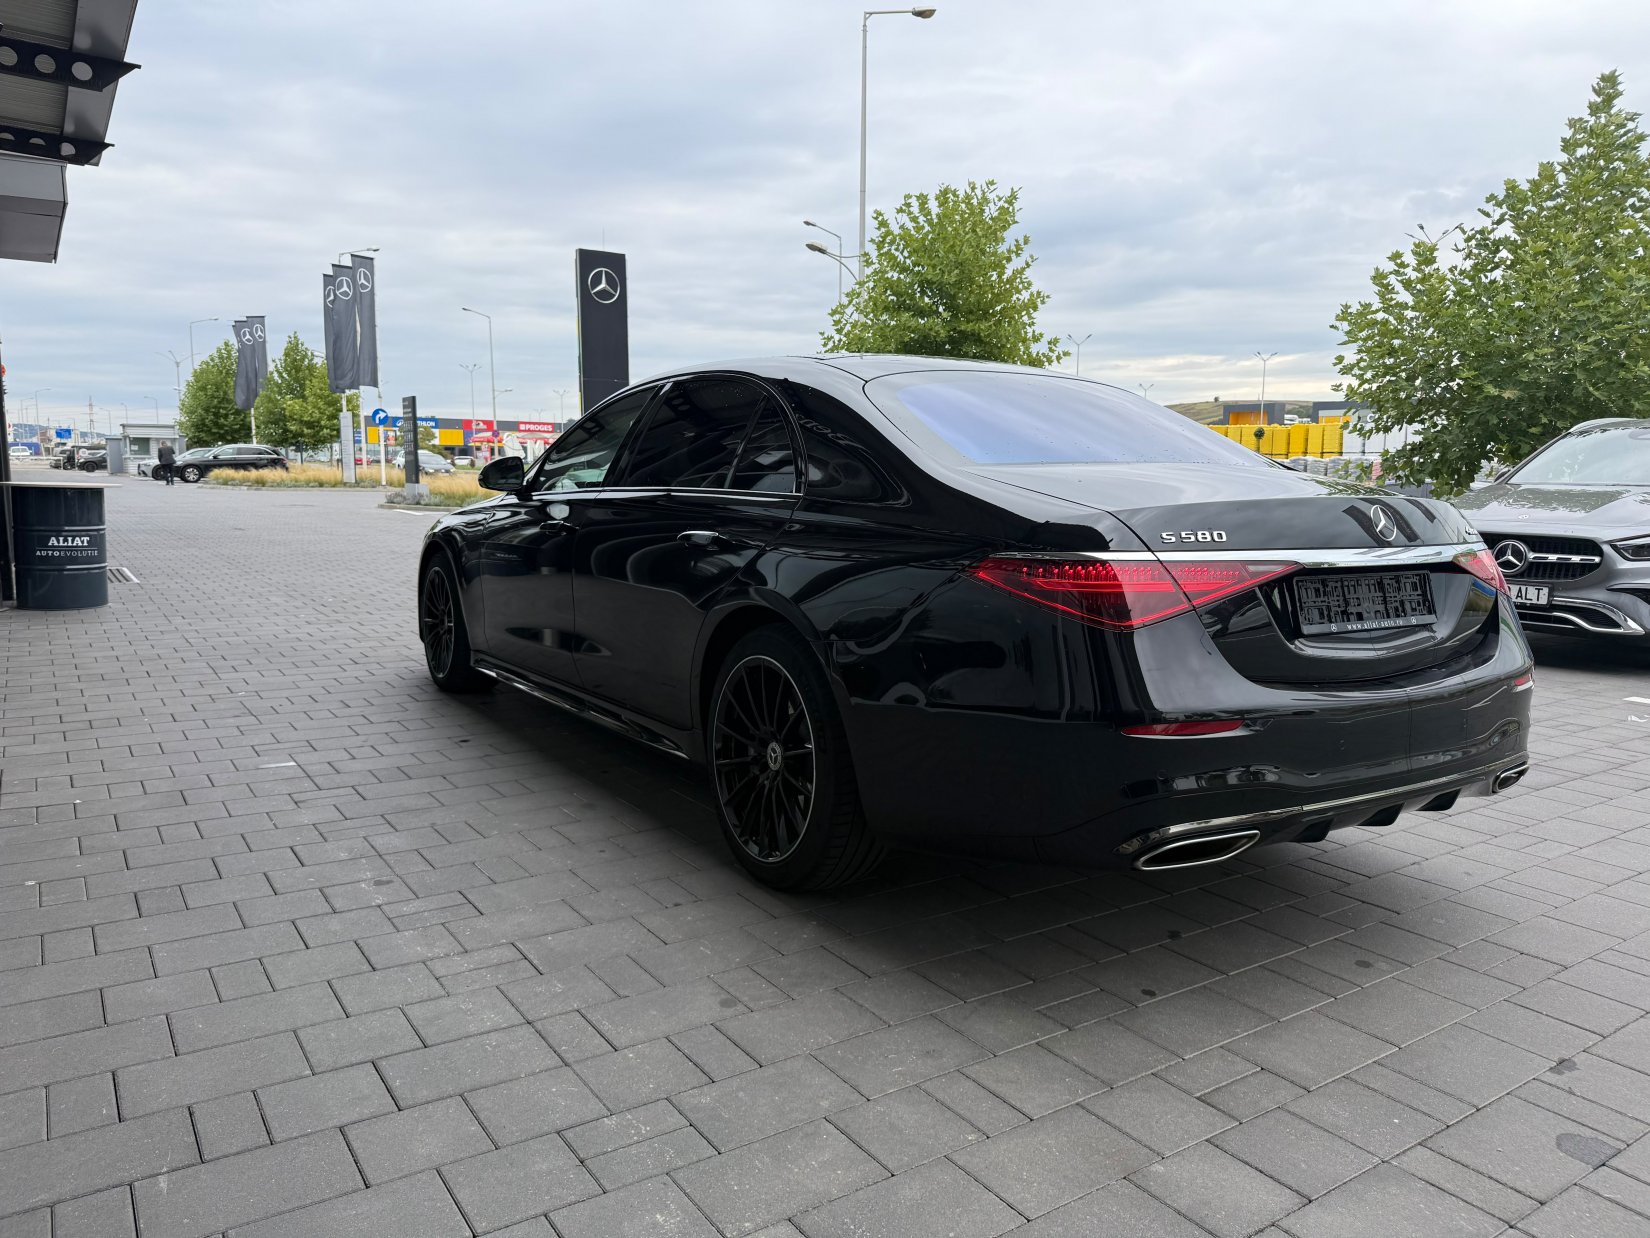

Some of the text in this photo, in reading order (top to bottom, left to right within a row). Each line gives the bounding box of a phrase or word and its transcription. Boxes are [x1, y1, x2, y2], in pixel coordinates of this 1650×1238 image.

[48, 537, 89, 546] ALIAT
[1160, 530, 1227, 543] S 580
[1515, 586, 1544, 602] ALT
